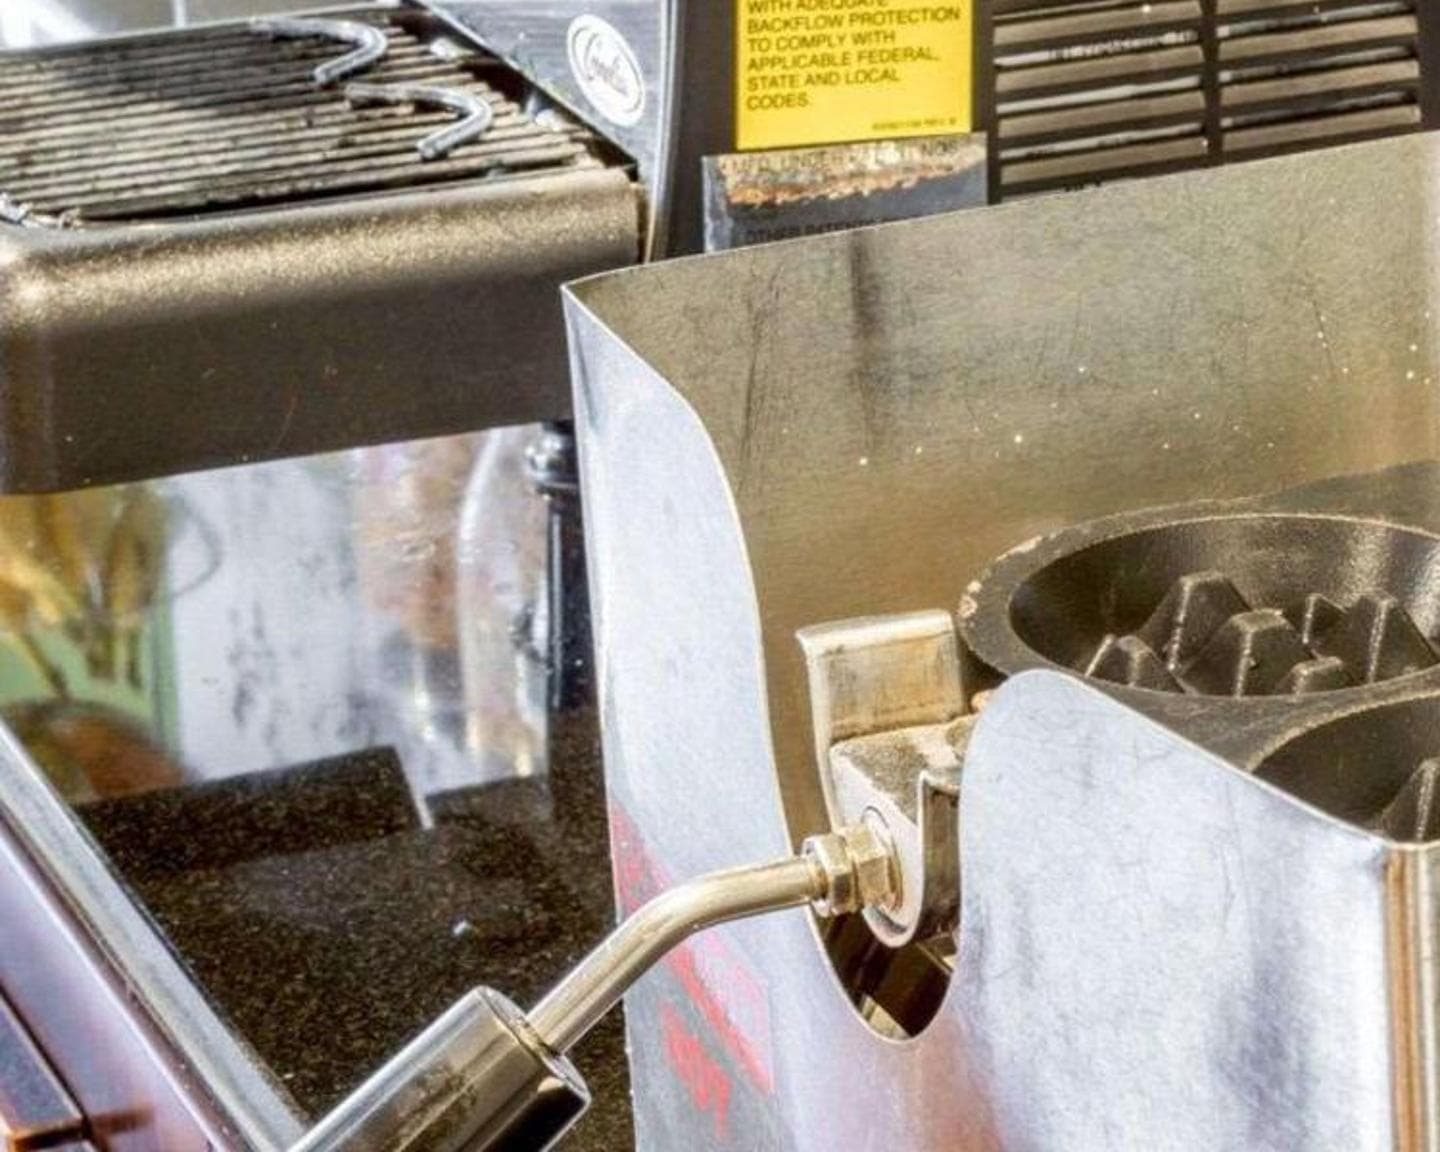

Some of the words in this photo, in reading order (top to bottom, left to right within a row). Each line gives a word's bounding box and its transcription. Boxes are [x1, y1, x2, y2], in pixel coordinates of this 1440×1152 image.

[748, 14, 844, 35] BACKFLOW
[848, 6, 961, 27] PROTECTION
[747, 36, 771, 53] TO
[776, 32, 847, 52] COMPLY
[851, 30, 896, 47] WITH
[748, 50, 851, 72] APPLICABLE
[748, 73, 800, 93] STATE
[804, 70, 841, 87] AND
[845, 66, 901, 85] LOCAL
